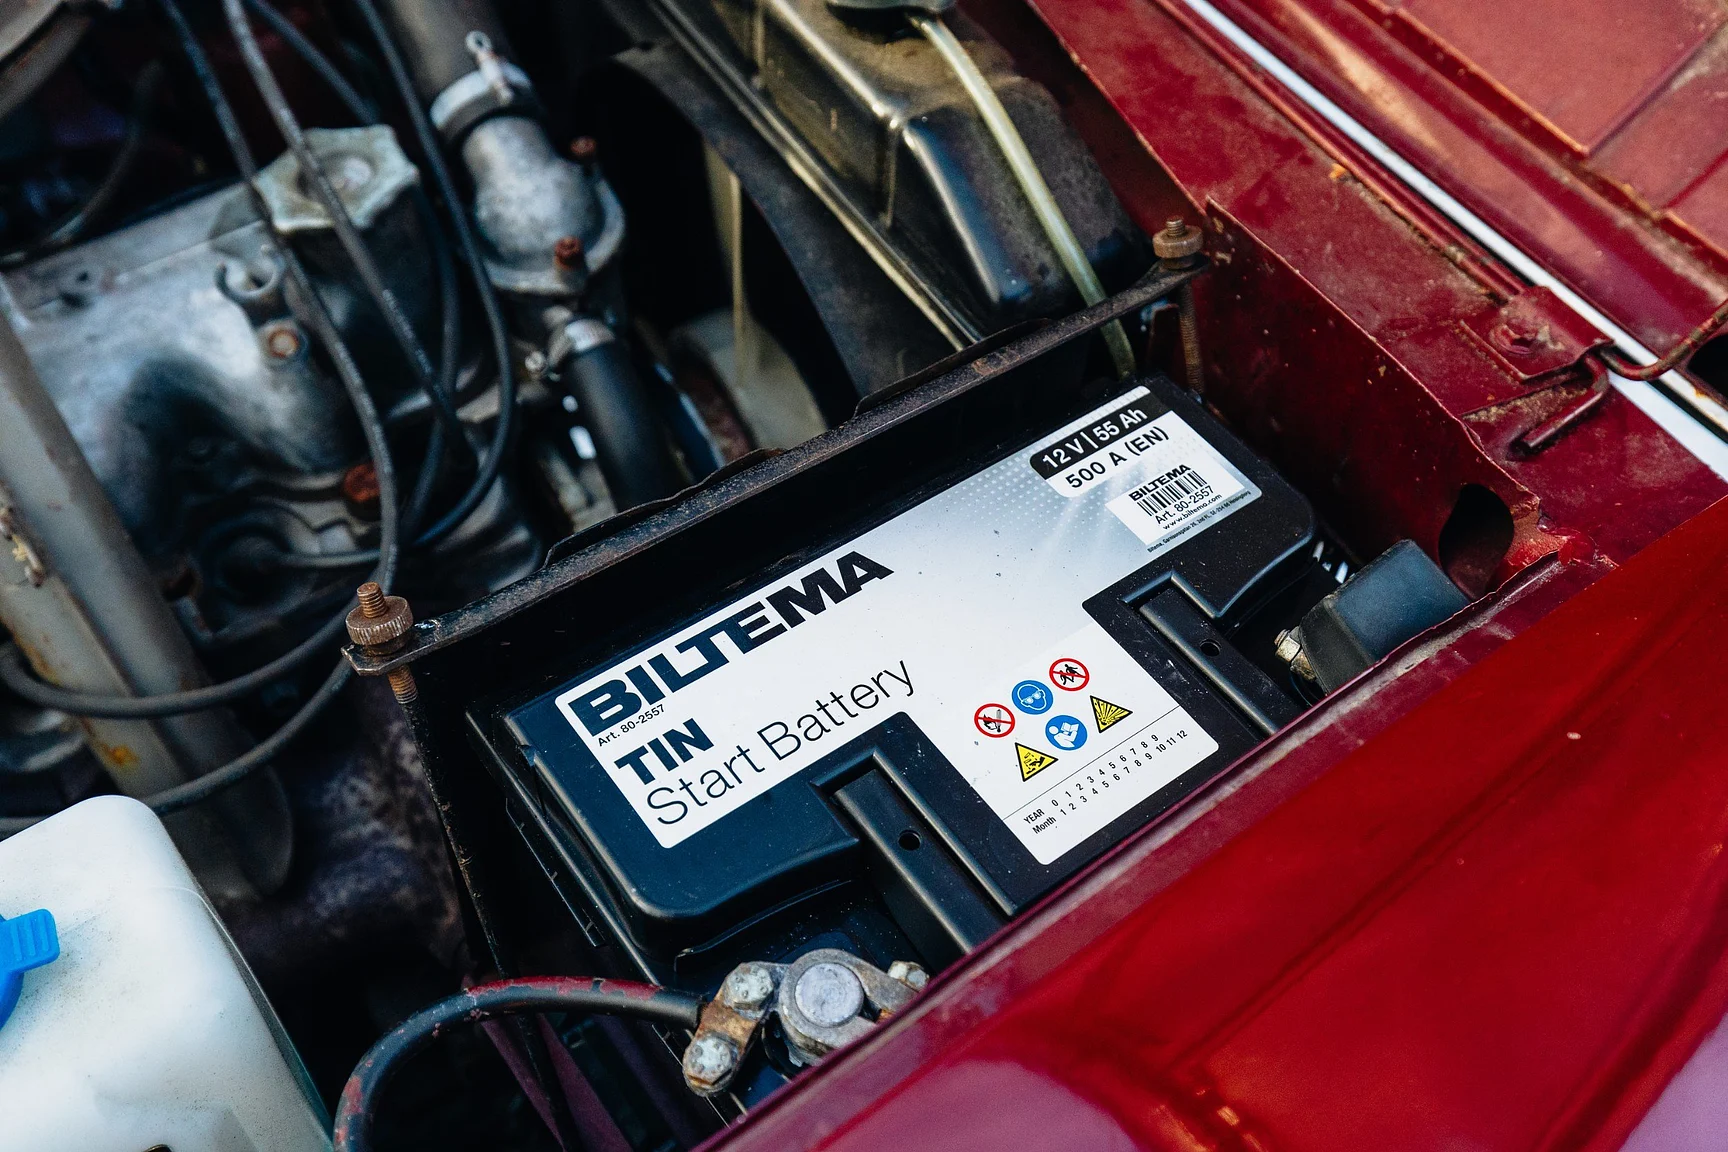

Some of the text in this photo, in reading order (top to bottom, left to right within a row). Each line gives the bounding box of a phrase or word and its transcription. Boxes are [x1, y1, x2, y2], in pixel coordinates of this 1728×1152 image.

[1043, 409, 1148, 468] 12 V 55 Ah
[1065, 426, 1170, 488] 500 A (EN)
[1128, 464, 1191, 501] BILTEMA
[1155, 485, 1214, 524] Art. 80-2557
[1162, 494, 1223, 530] www.biltema.com
[568, 550, 894, 737] BILTEMA
[597, 703, 666, 747] Art. 80-2557
[614, 717, 714, 786] TIN
[647, 660, 914, 825] Start Battery
[1023, 808, 1045, 825] YEAR
[1051, 799, 1059, 807] 0
[1065, 790, 1072, 798] 1
[1075, 783, 1084, 791] 2
[1087, 775, 1094, 784] 3
[1099, 768, 1105, 776] 4
[1119, 754, 1127, 762] 6
[1130, 747, 1137, 755] 7
[1141, 741, 1148, 749] 8
[1151, 734, 1159, 742] 9
[1032, 815, 1057, 834] Month
[1068, 802, 1076, 811] 2
[1080, 795, 1088, 803] 3
[1092, 788, 1098, 796] 4
[1113, 773, 1120, 781] 6
[1123, 766, 1131, 774] 7
[1134, 759, 1142, 767] 8
[1145, 752, 1153, 760] 9
[1156, 744, 1166, 753] 10
[1166, 737, 1177, 747] 11
[1177, 730, 1188, 739] 12
